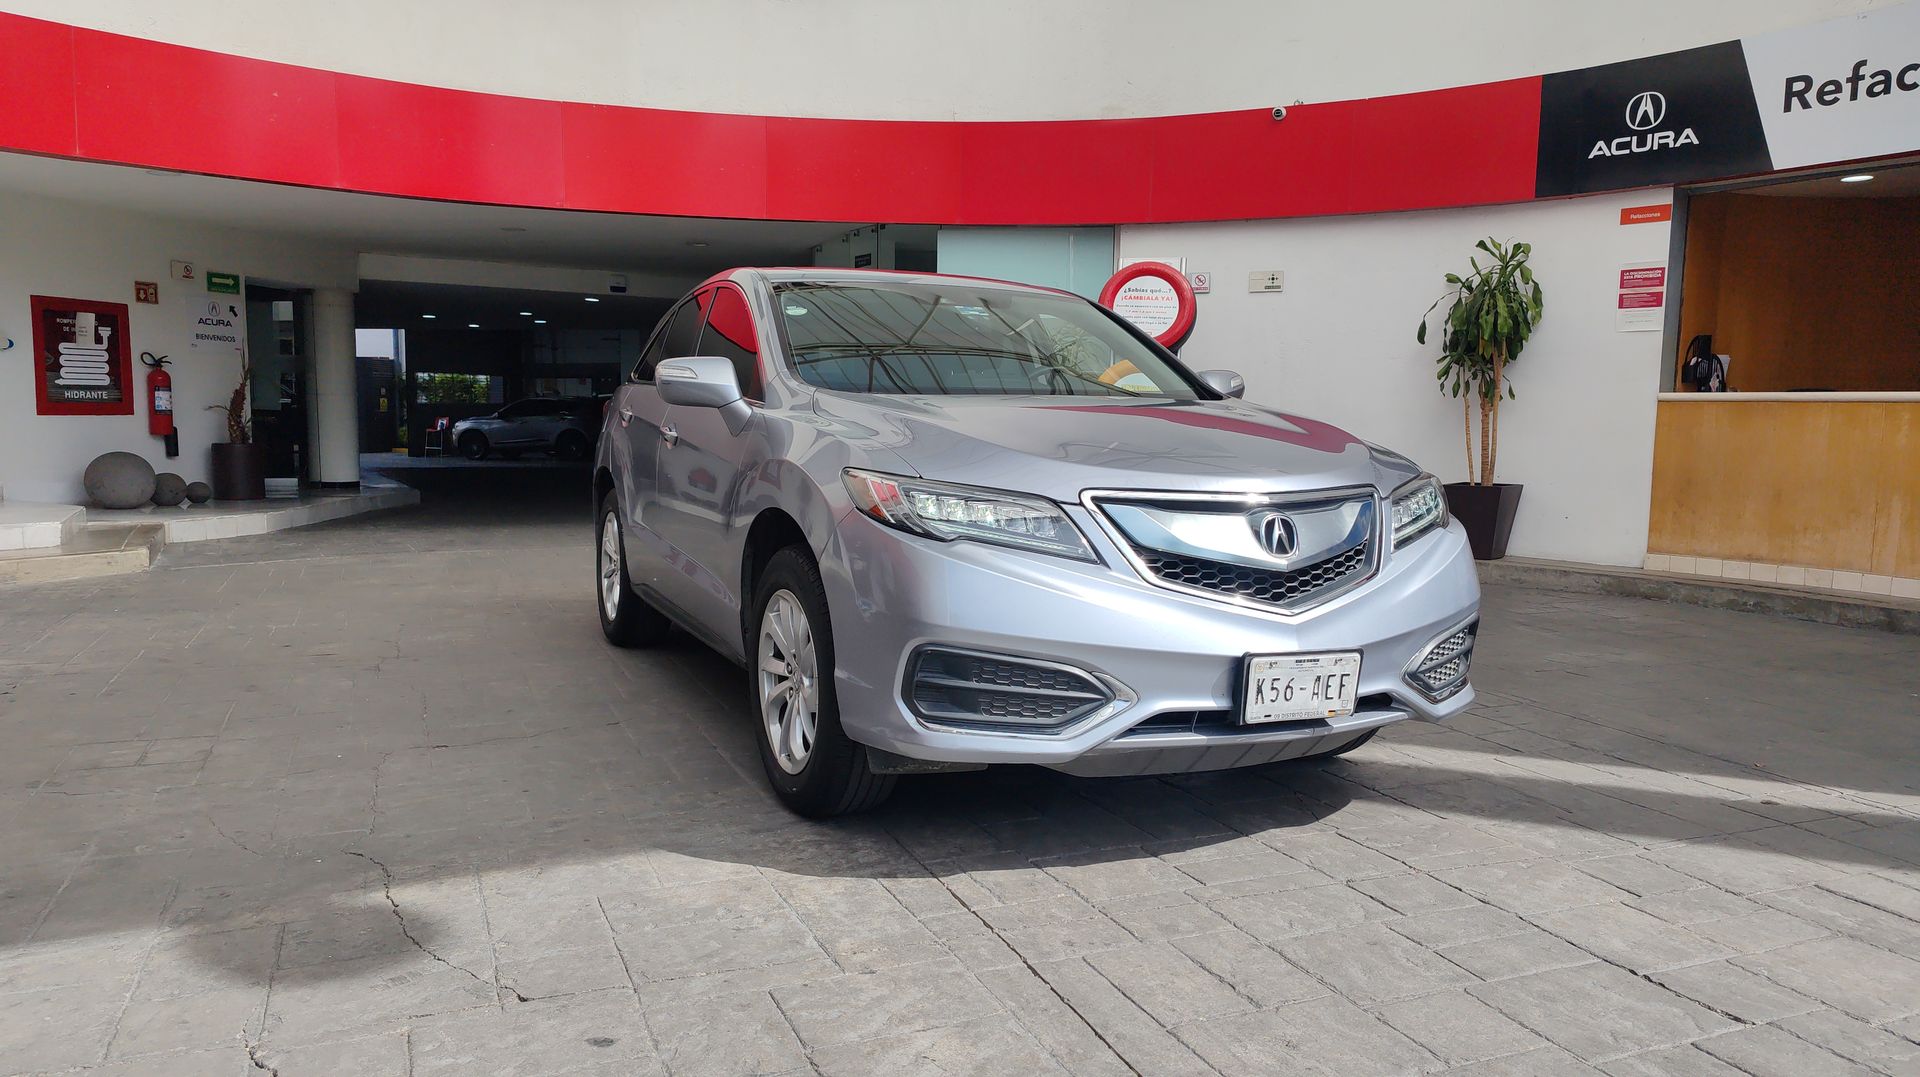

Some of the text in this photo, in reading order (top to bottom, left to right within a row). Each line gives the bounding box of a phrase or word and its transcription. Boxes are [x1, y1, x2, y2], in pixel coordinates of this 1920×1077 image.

[1783, 59, 1920, 113] Refac
[1588, 127, 1700, 159] ACURA
[198, 318, 233, 327] ACURA
[196, 333, 236, 343] BIENVENIDOS
[65, 391, 109, 399] HIDRANTE
[1255, 673, 1351, 705] K56-AEF
[1281, 711, 1303, 719] DISTRITO
[1304, 710, 1325, 718] FEDERAL
